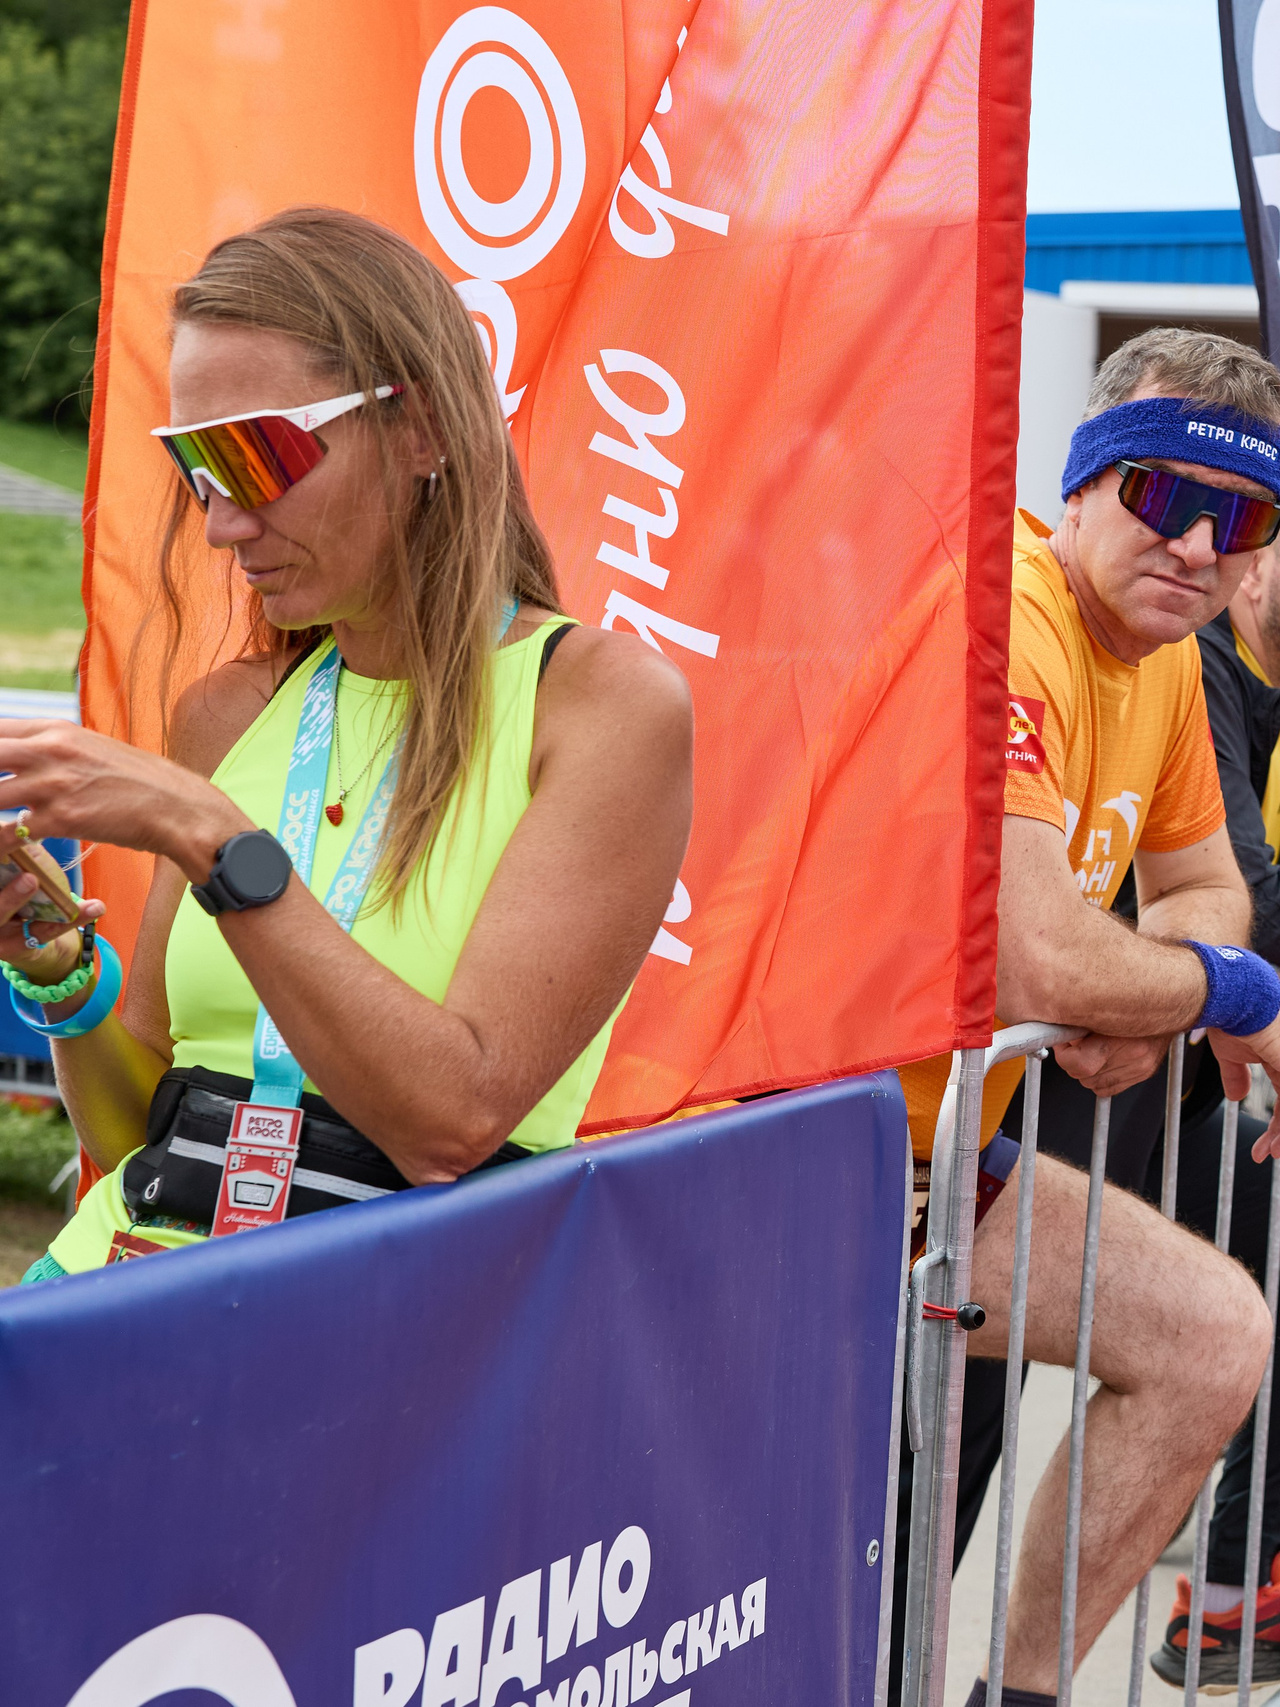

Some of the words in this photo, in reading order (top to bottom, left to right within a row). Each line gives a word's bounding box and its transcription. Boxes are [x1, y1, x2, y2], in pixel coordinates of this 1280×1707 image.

[1187, 421, 1235, 443] РЕТРО
[1240, 434, 1278, 460] КРОСС
[1005, 749, 1038, 764] ГНИТ
[282, 791, 310, 866] РОСС
[302, 787, 321, 882] культурника
[247, 1127, 284, 1138] КРОСС
[248, 1116, 282, 1128] РЕТРО
[353, 1525, 651, 1707] РАДИО
